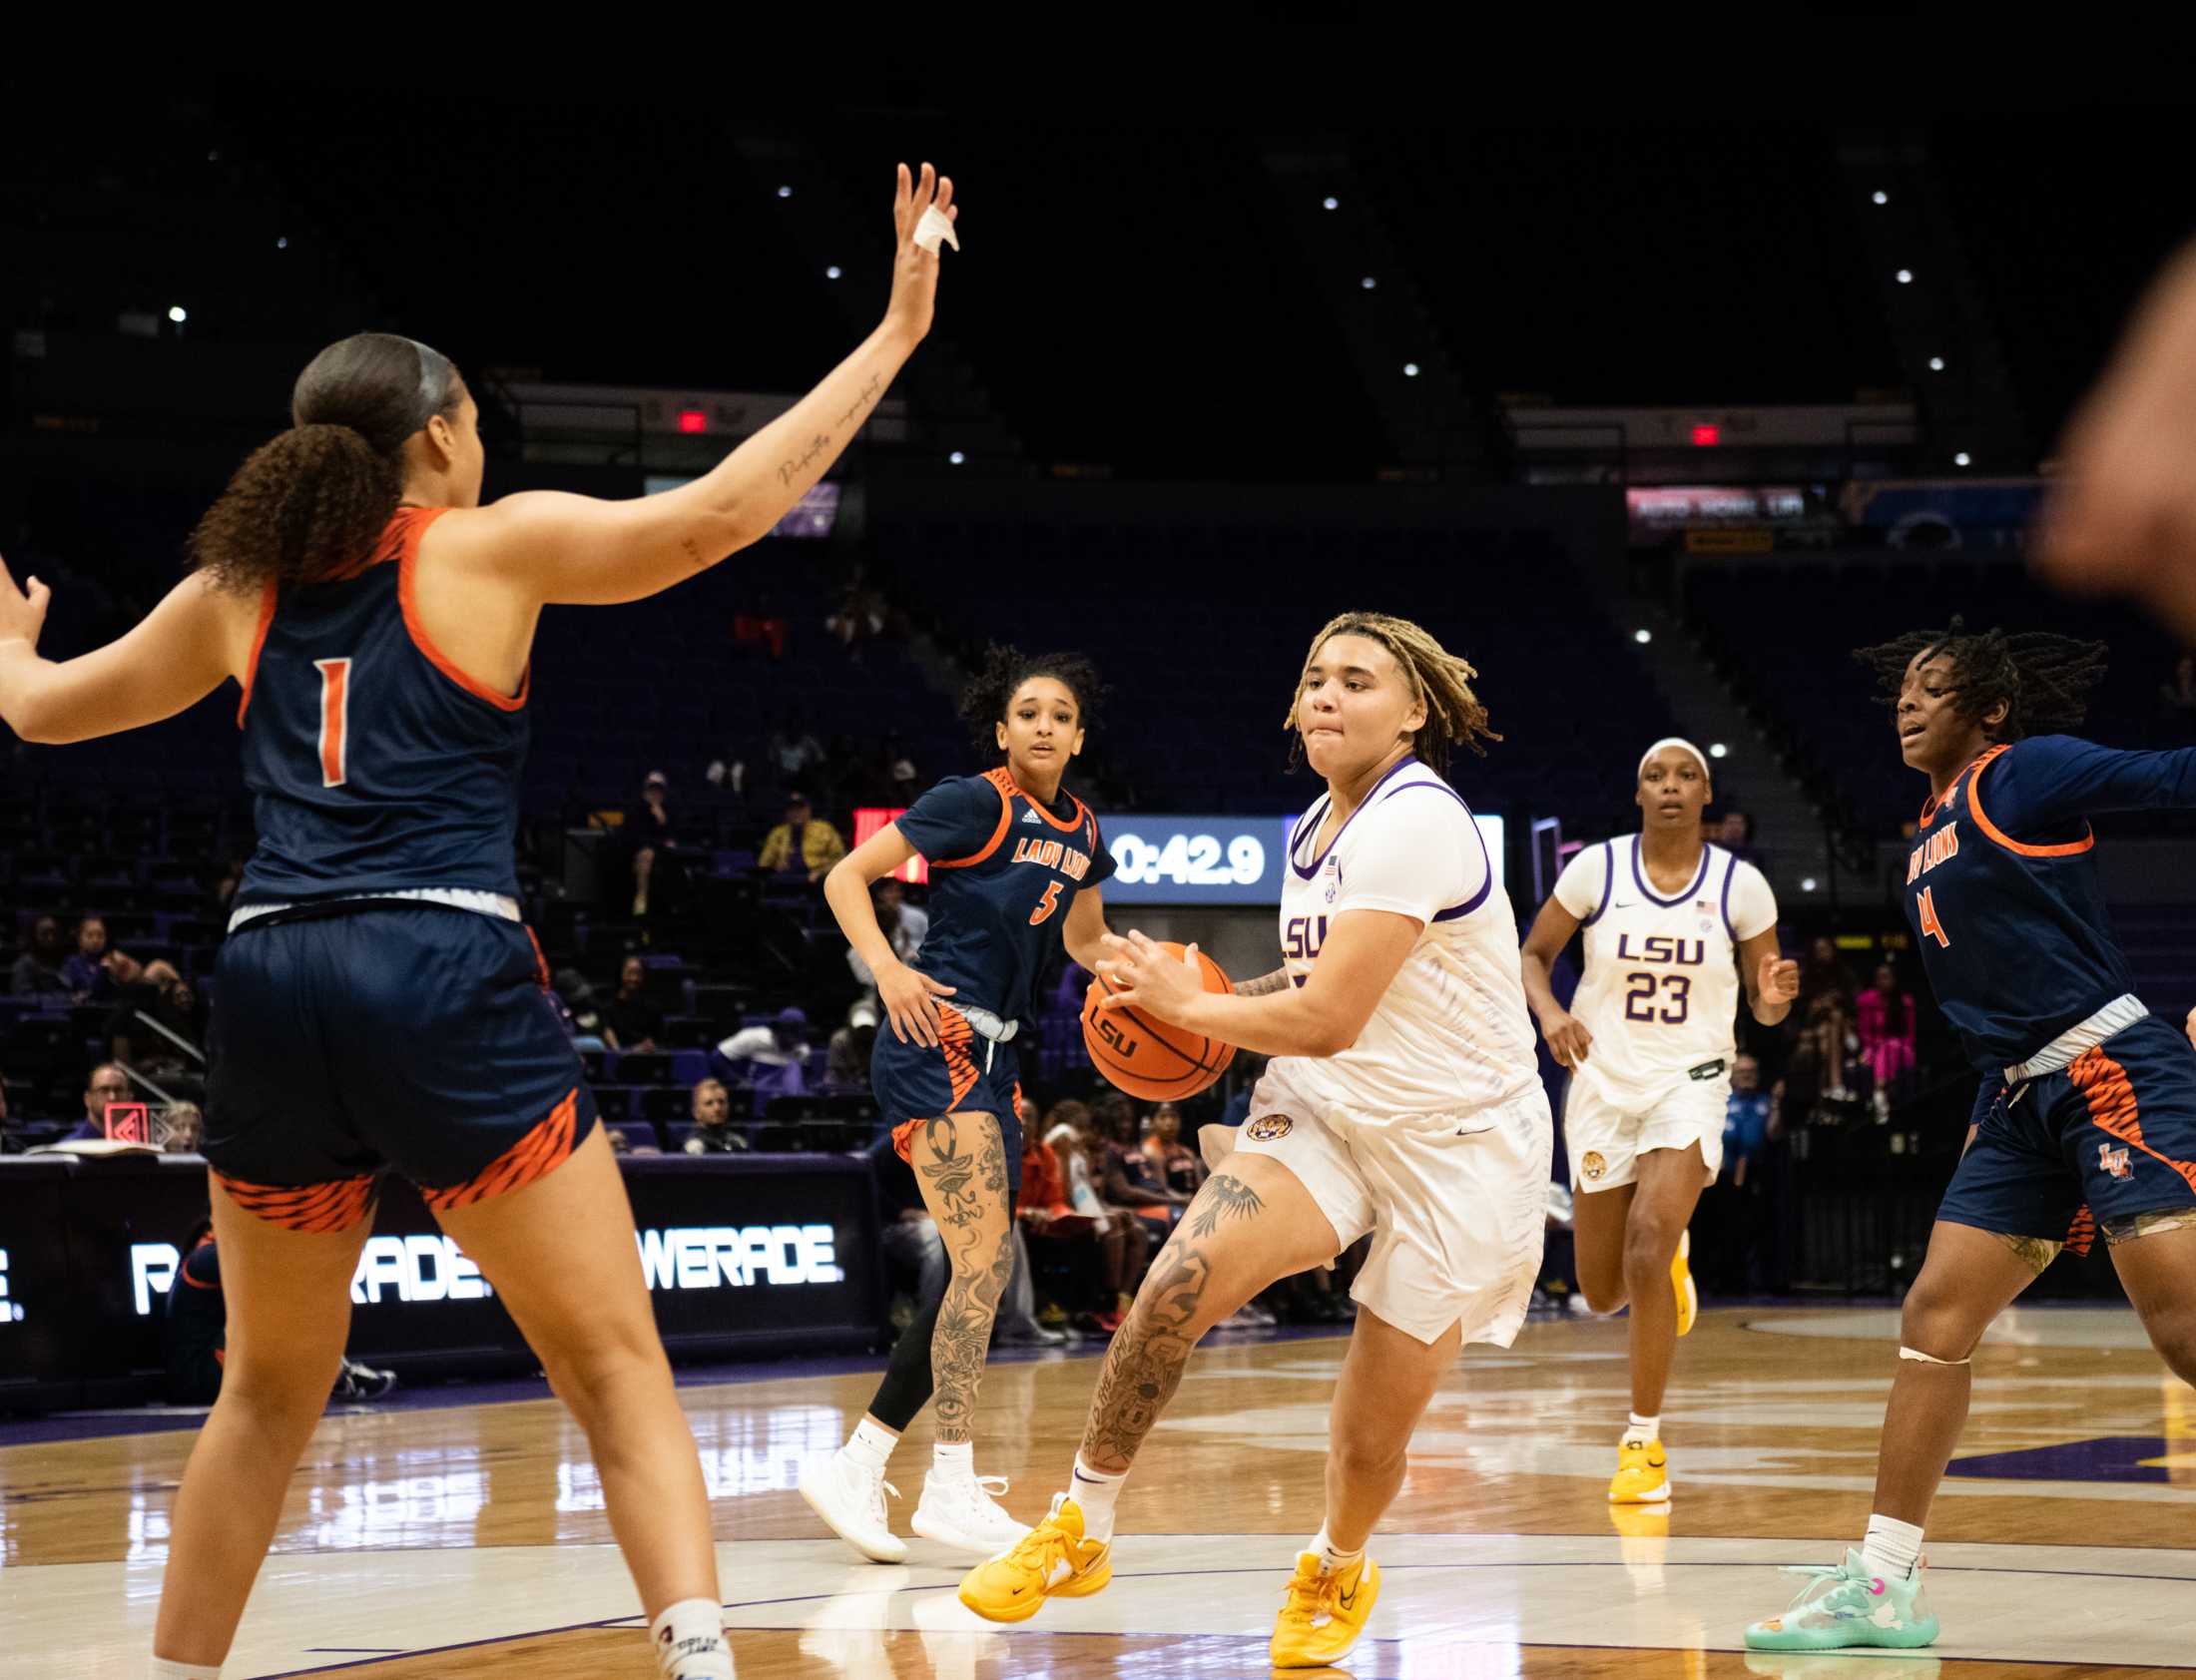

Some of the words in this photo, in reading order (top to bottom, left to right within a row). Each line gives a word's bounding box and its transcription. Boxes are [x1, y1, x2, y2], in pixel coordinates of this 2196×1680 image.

[312, 657, 352, 789] 1
[1011, 837, 1064, 868] LADY
[1109, 834, 1265, 884] 0:42.9
[1907, 843, 1924, 885] DY
[1922, 821, 1958, 874] LIONS
[1029, 879, 1065, 925] 5
[1916, 885, 1950, 948] 4
[1282, 915, 1328, 958] SU
[1617, 933, 1705, 966] LSU
[1624, 972, 1691, 1024] 23
[1090, 1005, 1138, 1058] LSU
[635, 1225, 835, 1291] WERADE
